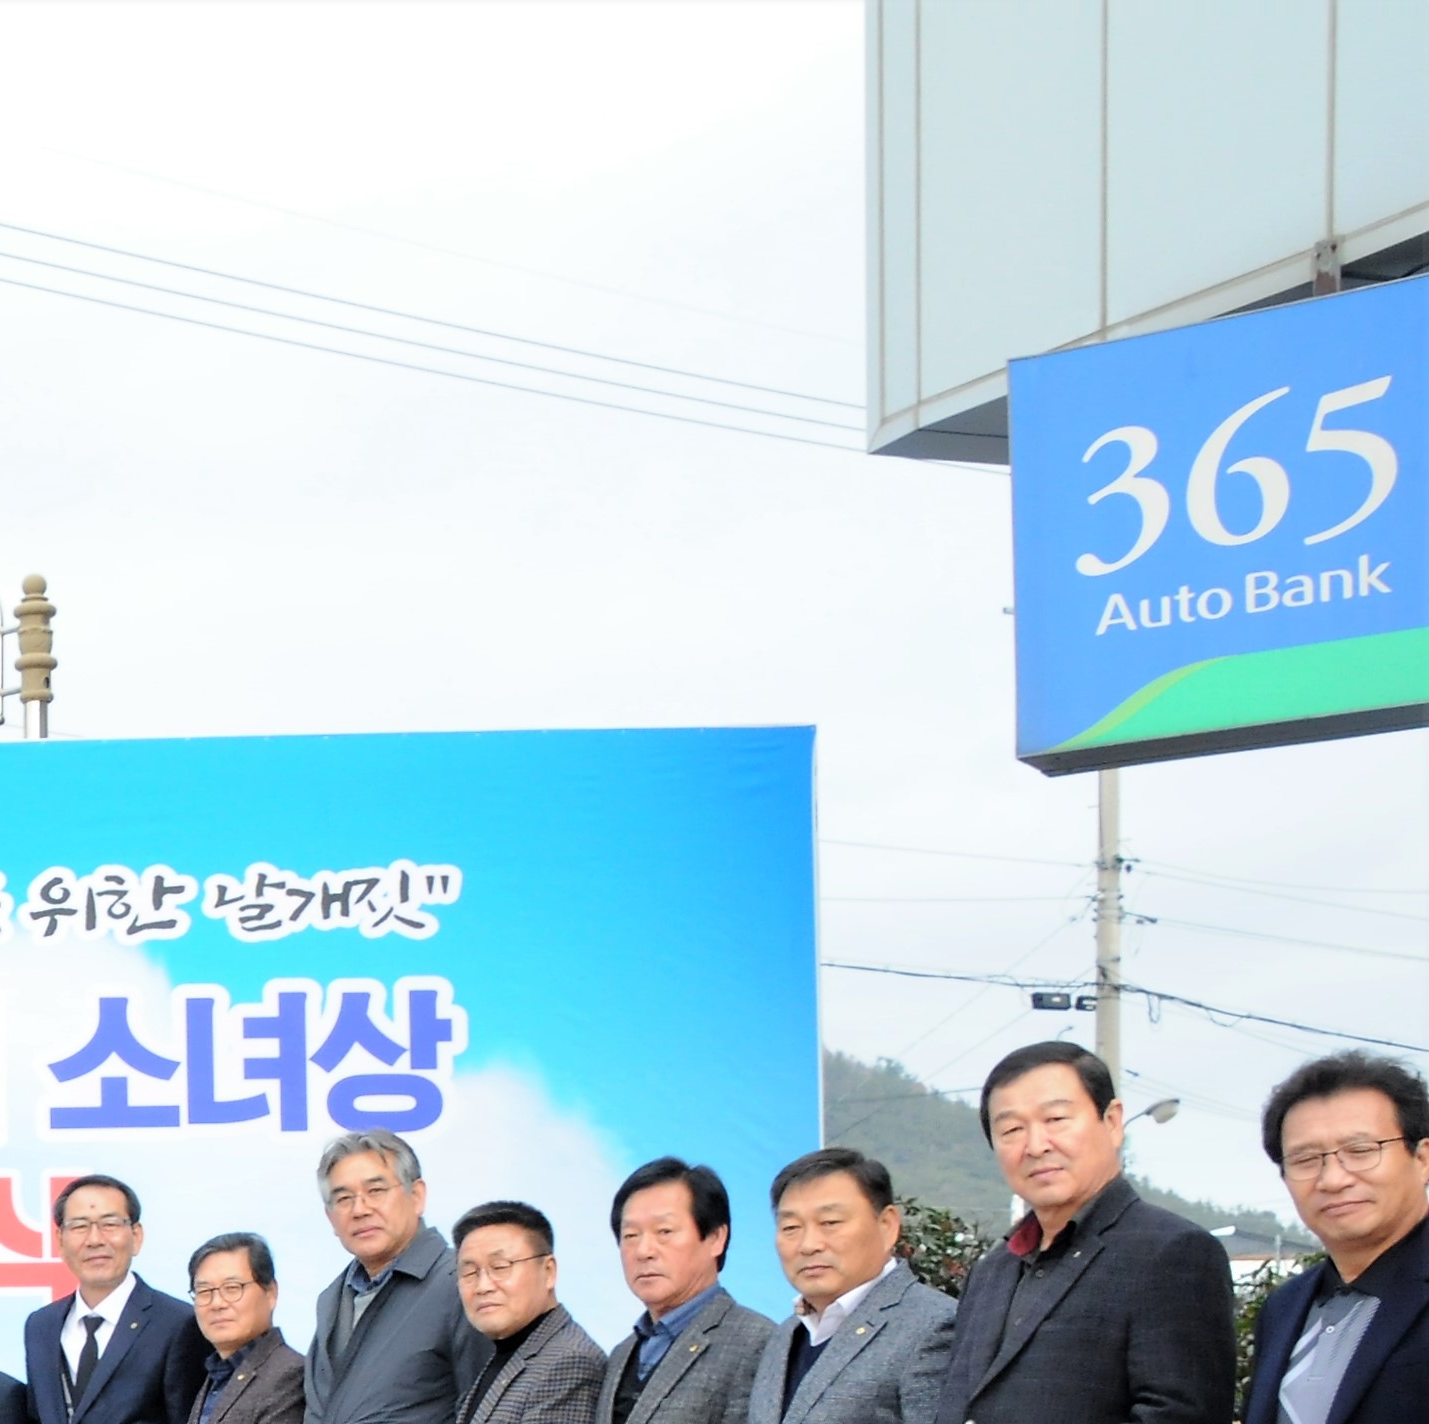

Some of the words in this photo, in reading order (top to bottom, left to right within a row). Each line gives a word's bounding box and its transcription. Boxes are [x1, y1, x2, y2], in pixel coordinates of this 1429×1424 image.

[1075, 375, 1398, 577] 365
[1095, 586, 1233, 636] Auto
[1244, 554, 1392, 614] Bank
[29, 874, 186, 937] 위한
[47, 989, 452, 1133] 소녀상
